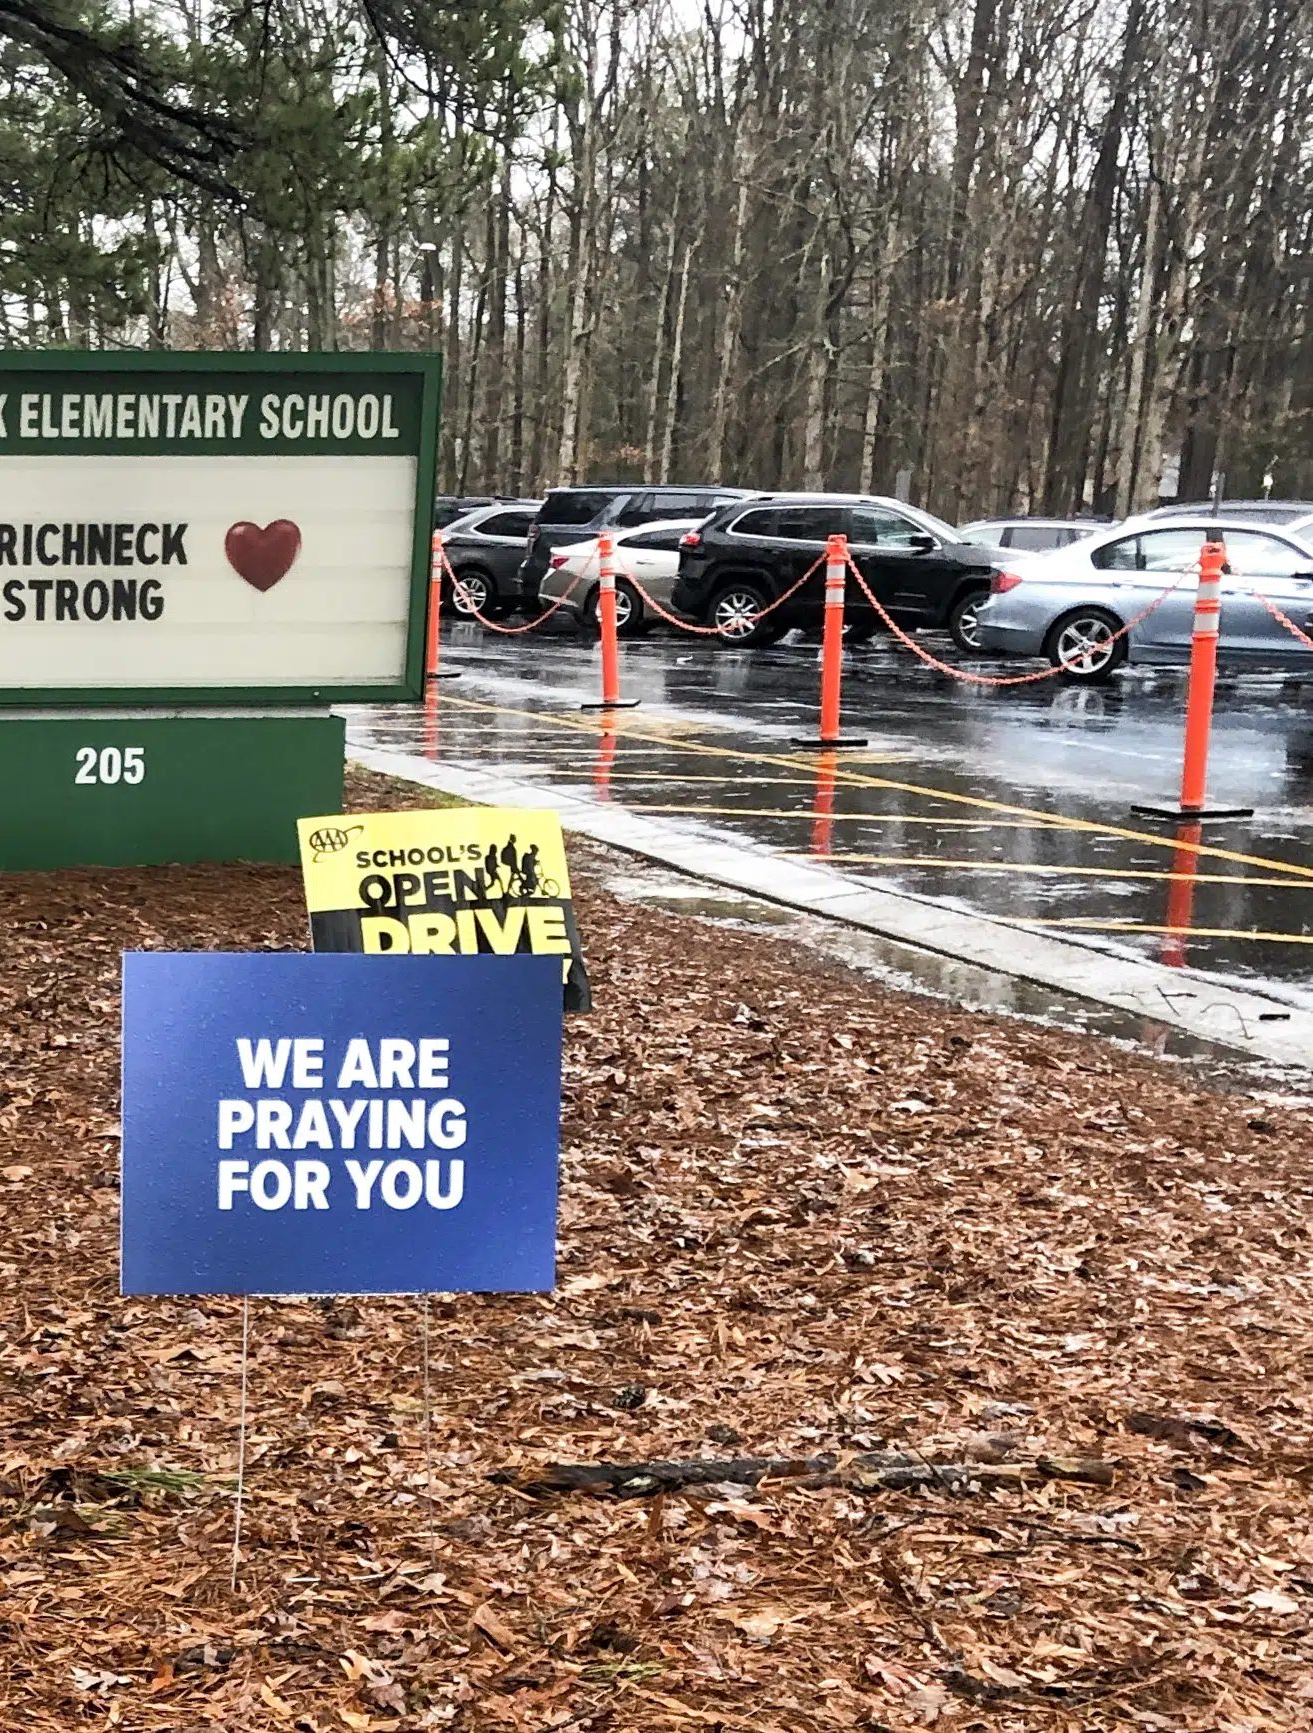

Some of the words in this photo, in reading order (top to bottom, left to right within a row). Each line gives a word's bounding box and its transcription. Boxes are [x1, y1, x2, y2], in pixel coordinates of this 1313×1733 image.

[19, 394, 248, 439] ELEMENTARY
[259, 393, 400, 439] SCHOOL
[2, 579, 165, 622] STRONG
[74, 746, 145, 785] 205
[310, 829, 348, 852] AAA
[356, 843, 483, 869] SCHOOL'S
[358, 868, 489, 909] OPEN
[361, 906, 572, 955] DRIVE
[236, 1038, 324, 1089] WE
[337, 1038, 450, 1089] ARE
[218, 1098, 467, 1150] PRAYING
[218, 1159, 330, 1211] FOR
[345, 1159, 465, 1210] YOU
